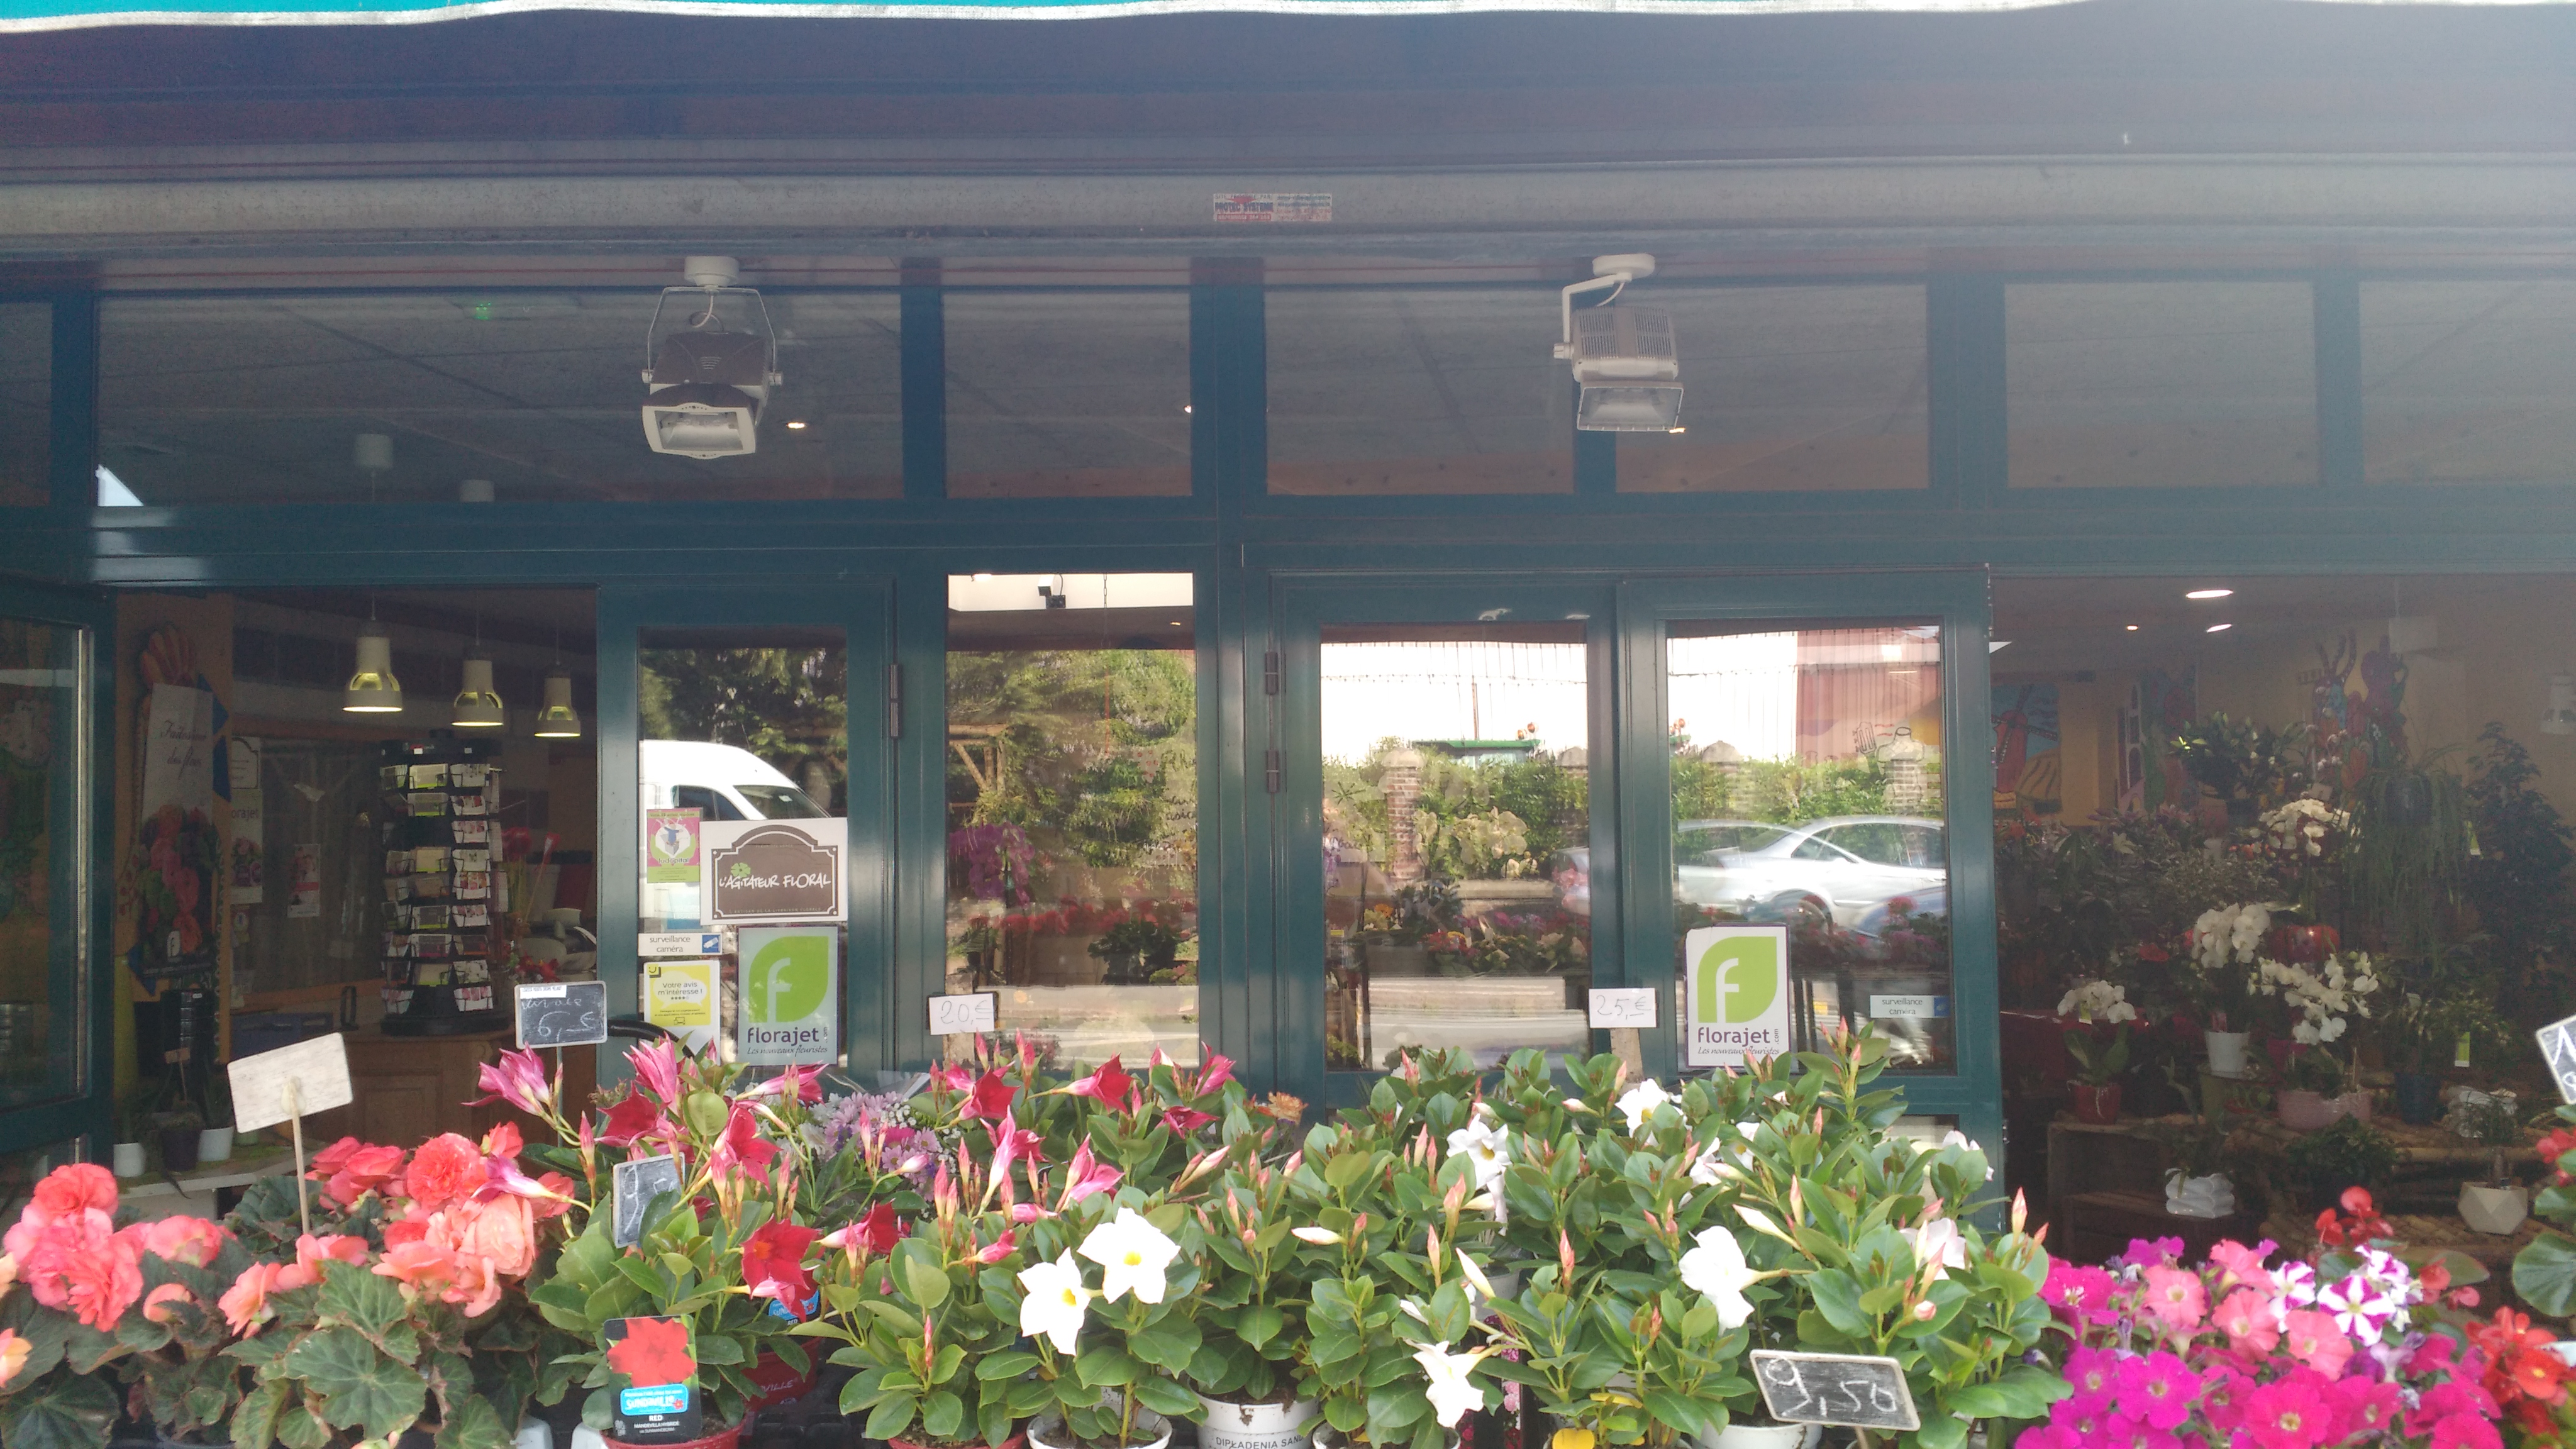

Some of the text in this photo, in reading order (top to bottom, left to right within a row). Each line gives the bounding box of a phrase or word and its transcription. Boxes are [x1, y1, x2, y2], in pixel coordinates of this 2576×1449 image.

[783, 872, 831, 889] FLORAL
[650, 935, 691, 943] surveillance
[747, 1026, 819, 1046] florajet
[1697, 1026, 1770, 1047] florajet
[794, 1045, 828, 1057] fleuristes
[1698, 1046, 1709, 1055] Les
[761, 1379, 794, 1392] VILLE
